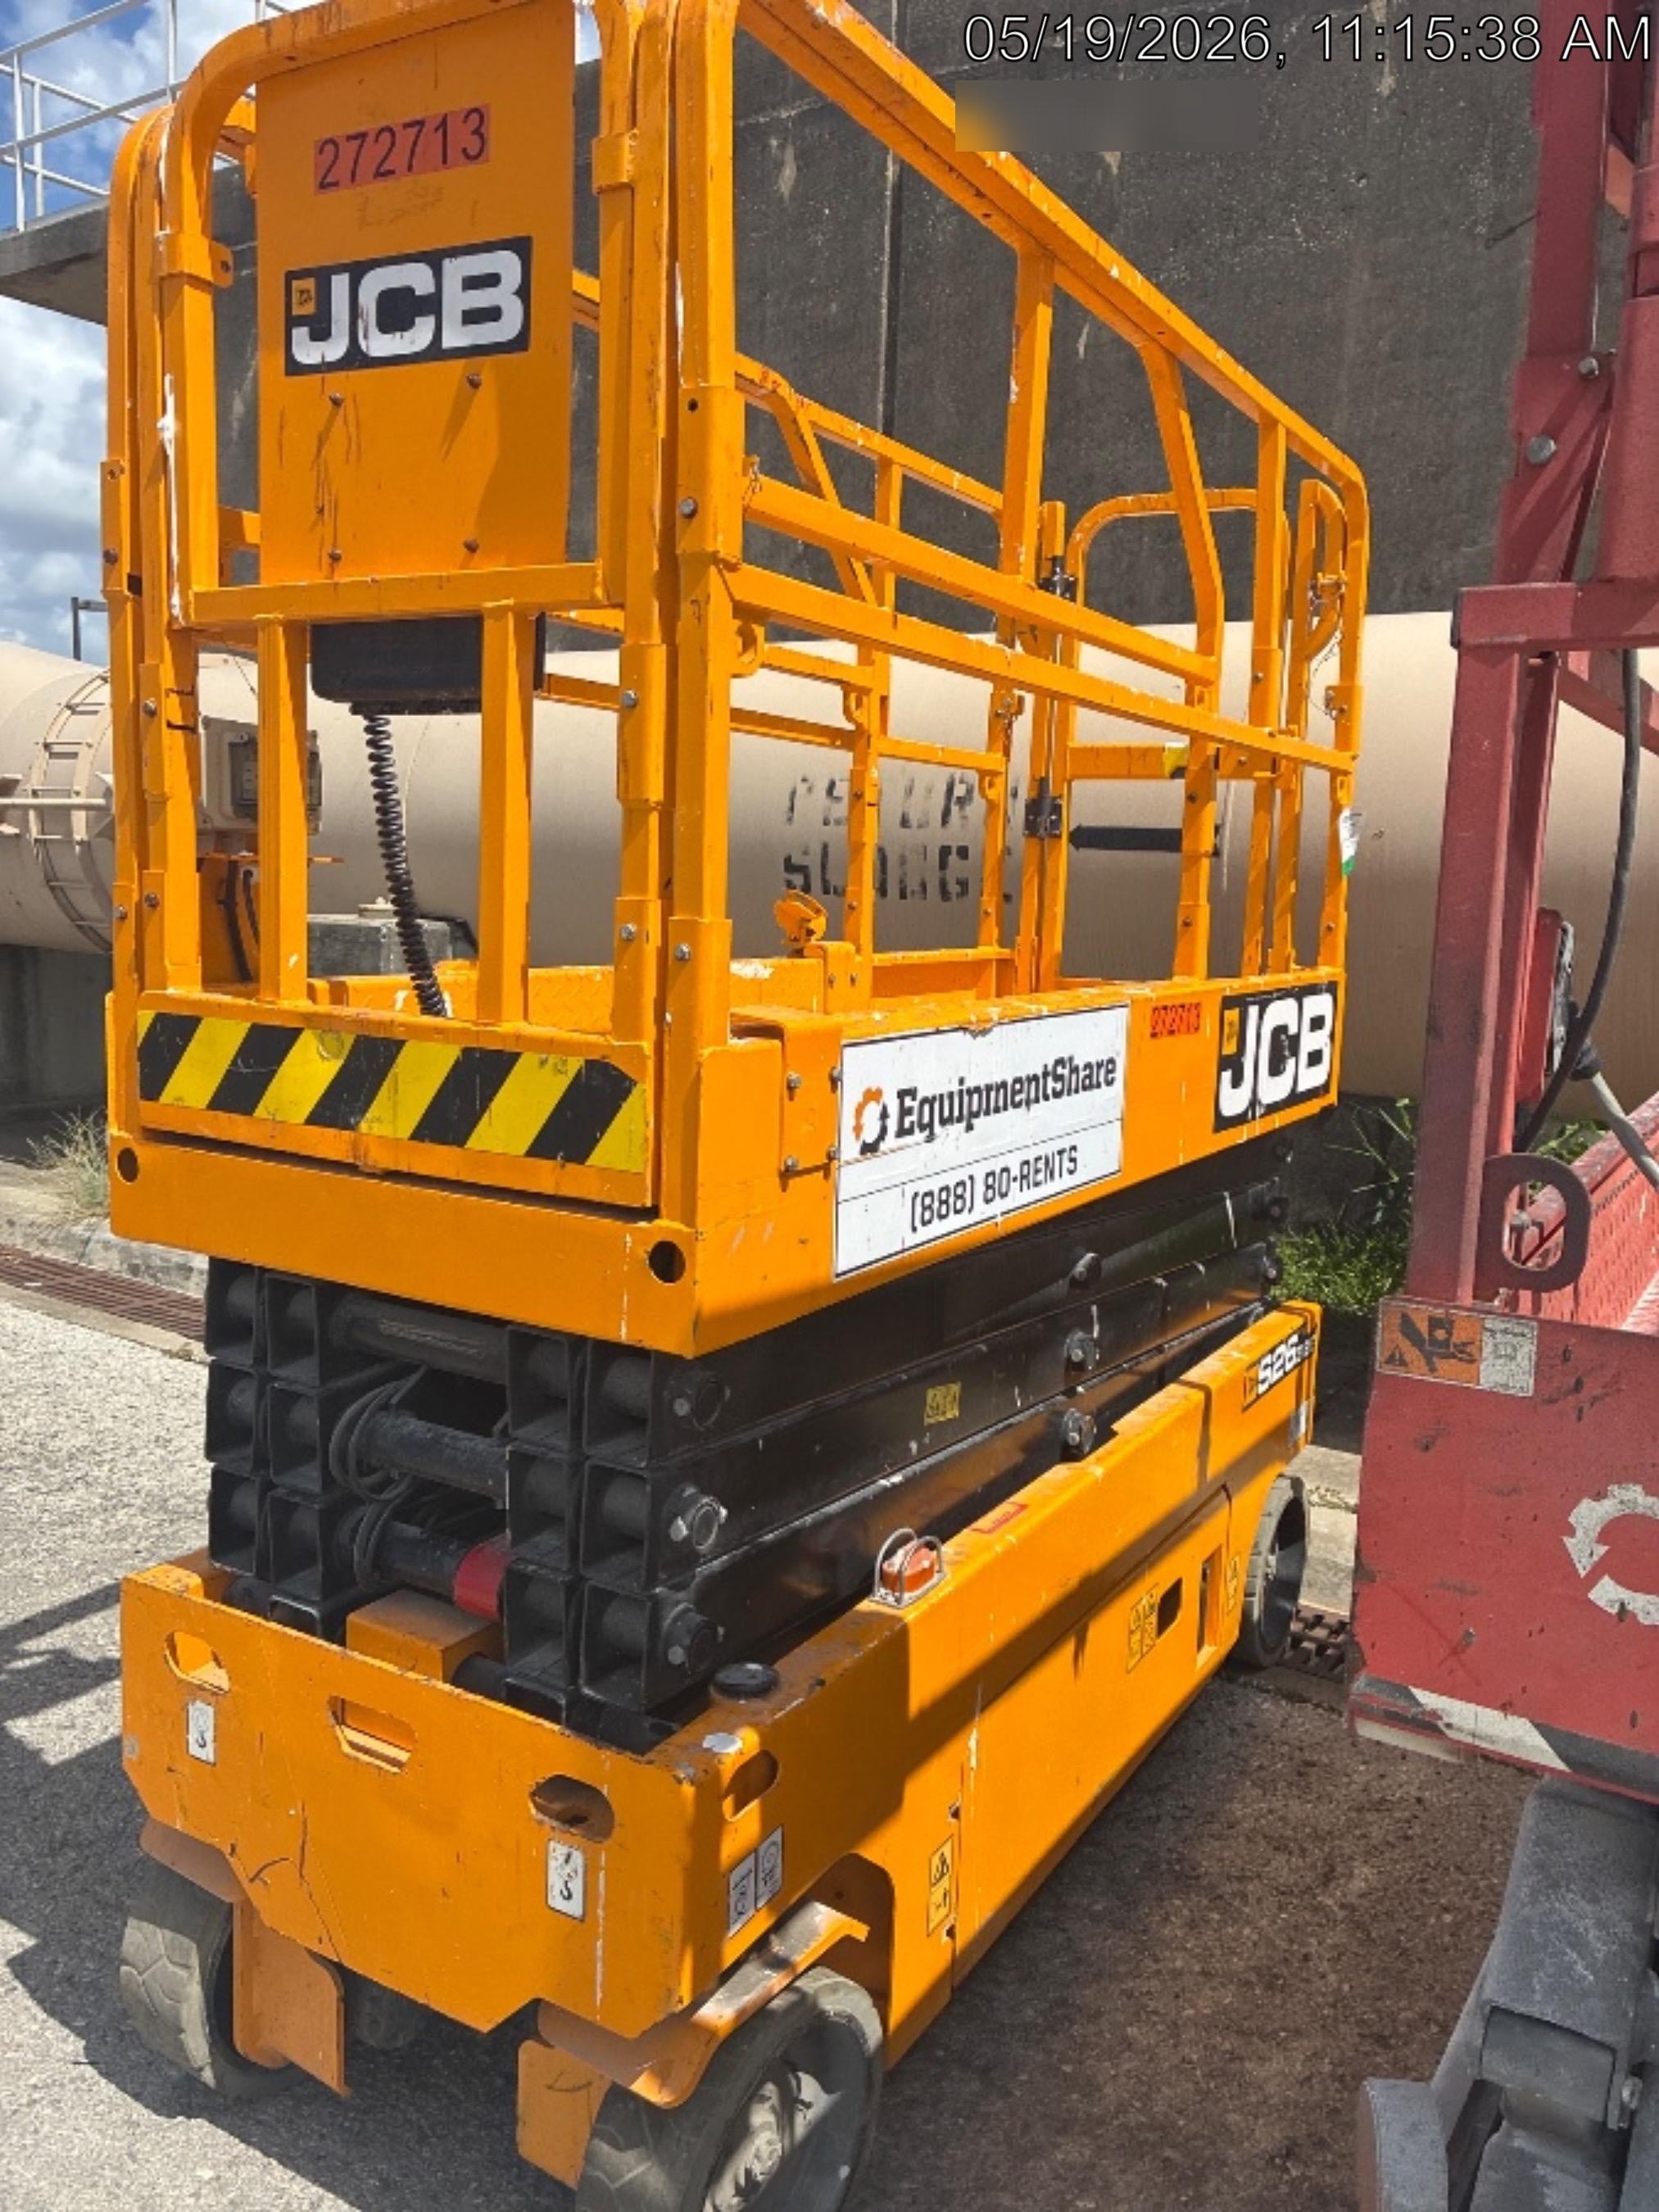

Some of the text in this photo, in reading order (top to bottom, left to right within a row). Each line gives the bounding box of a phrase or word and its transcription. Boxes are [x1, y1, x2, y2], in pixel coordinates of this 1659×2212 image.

[318, 107, 485, 190] 272713
[292, 250, 524, 365] JCB
[895, 1054, 1117, 1143] EquipmentShare
[1219, 993, 1333, 1117] JCB
[911, 1145, 1077, 1232] (888) 80-RENTS
